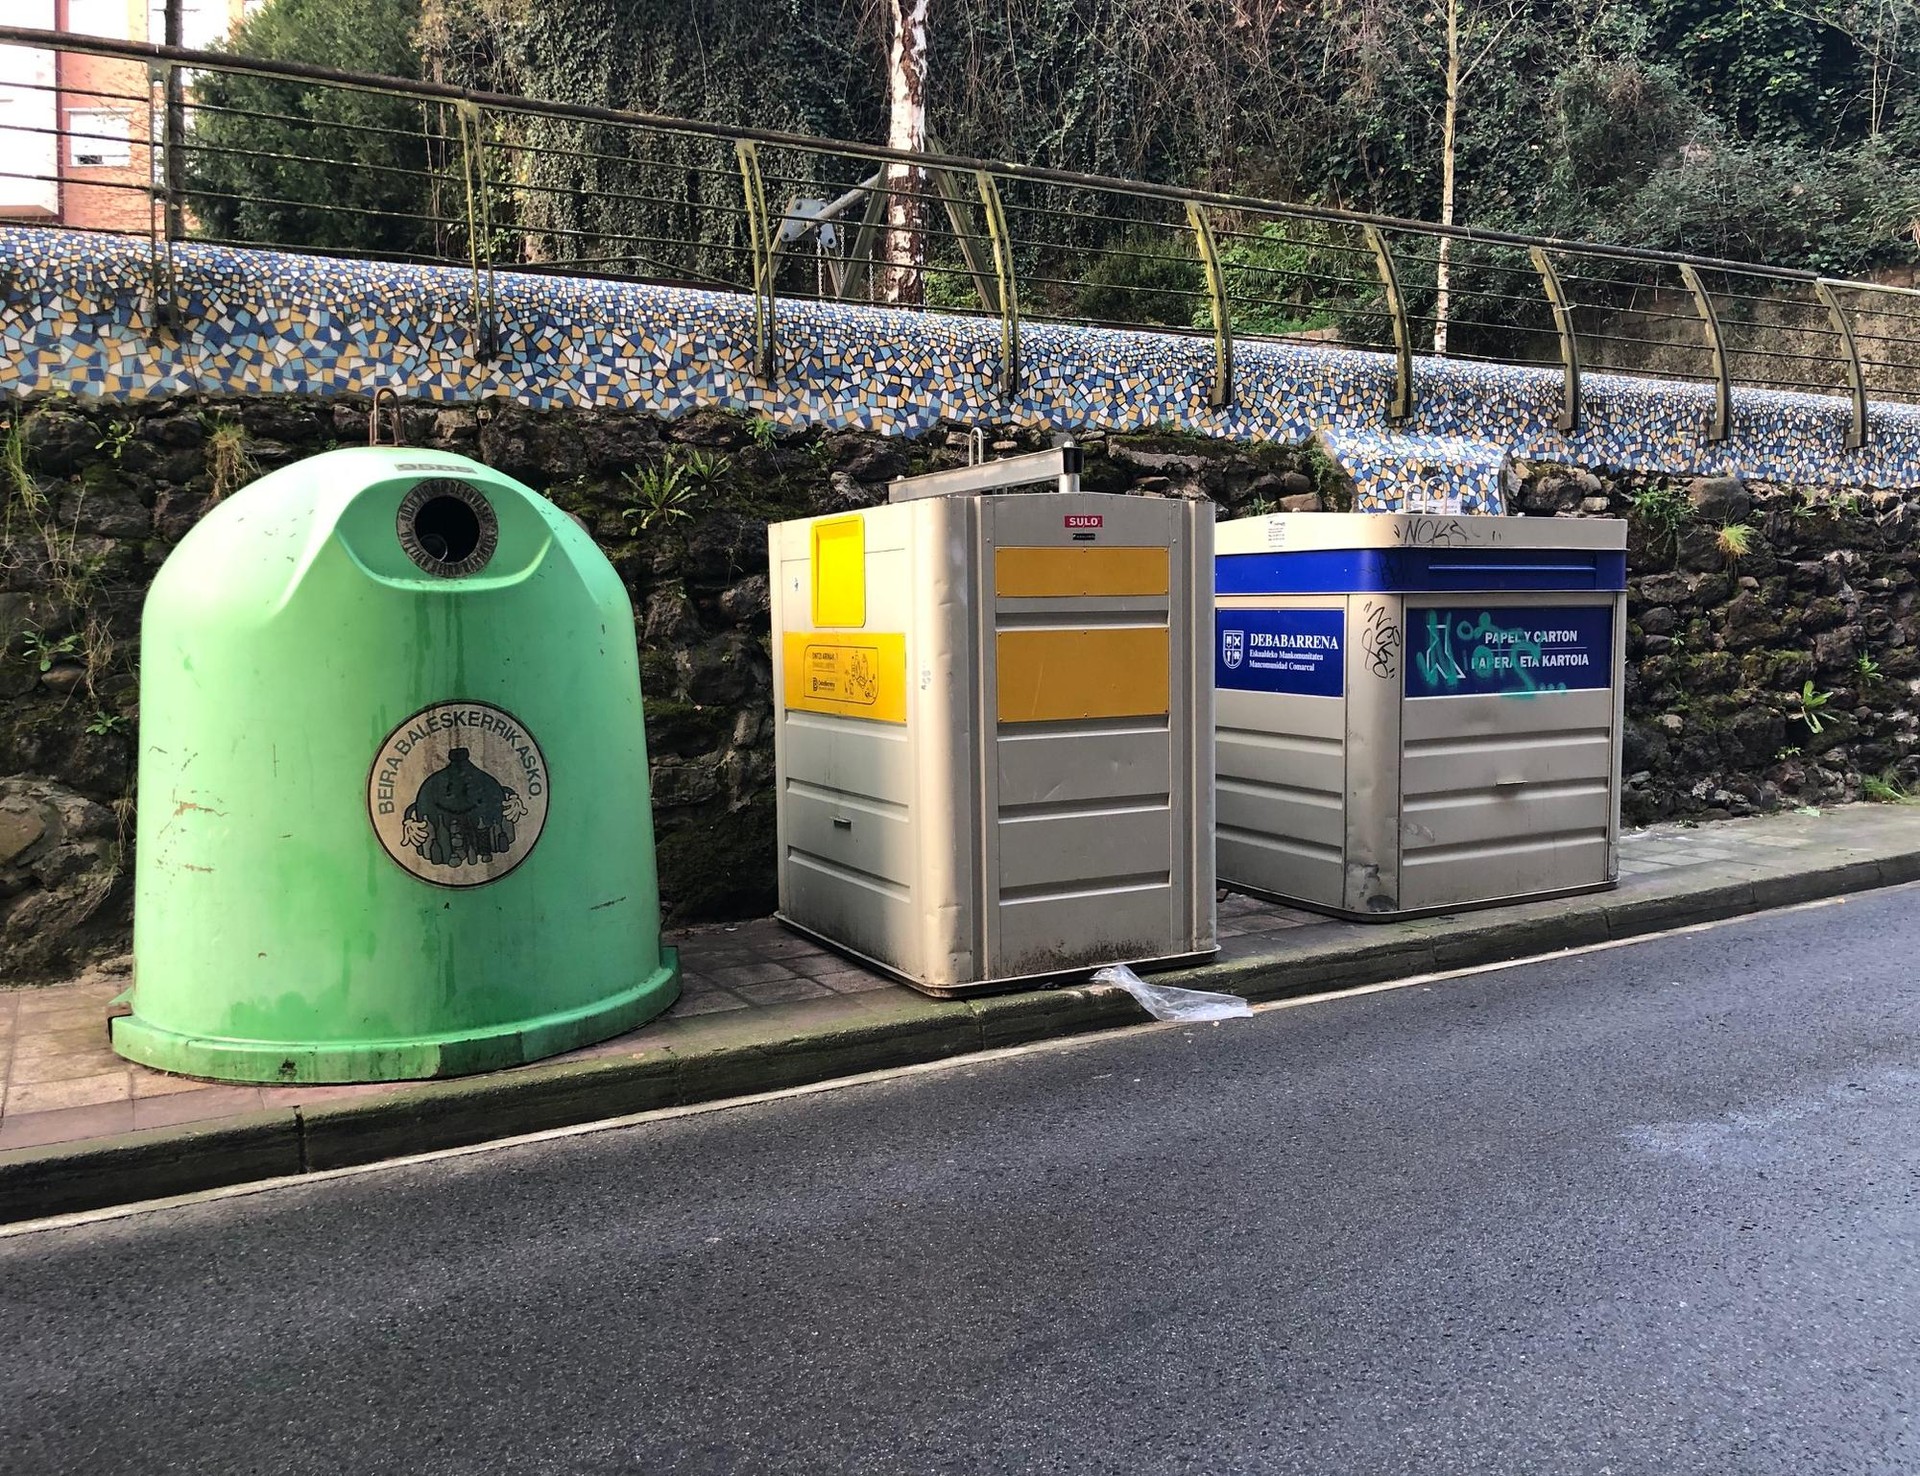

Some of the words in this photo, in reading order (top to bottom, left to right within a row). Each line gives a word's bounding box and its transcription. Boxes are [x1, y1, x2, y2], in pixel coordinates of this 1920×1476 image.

[1069, 517, 1099, 527] SULO
[1249, 633, 1339, 650] DEBABARRENA
[1484, 631, 1521, 644] PAPEL
[1523, 630, 1532, 642] Y
[1533, 630, 1578, 643] CARTON
[1249, 659, 1288, 670] Mancomunidad
[1288, 661, 1315, 672] Comarcal
[1520, 655, 1540, 668] ETA
[1542, 653, 1590, 667] KARTOIA
[377, 755, 404, 815] BEIRA
[426, 710, 523, 749] ESKERRIK
